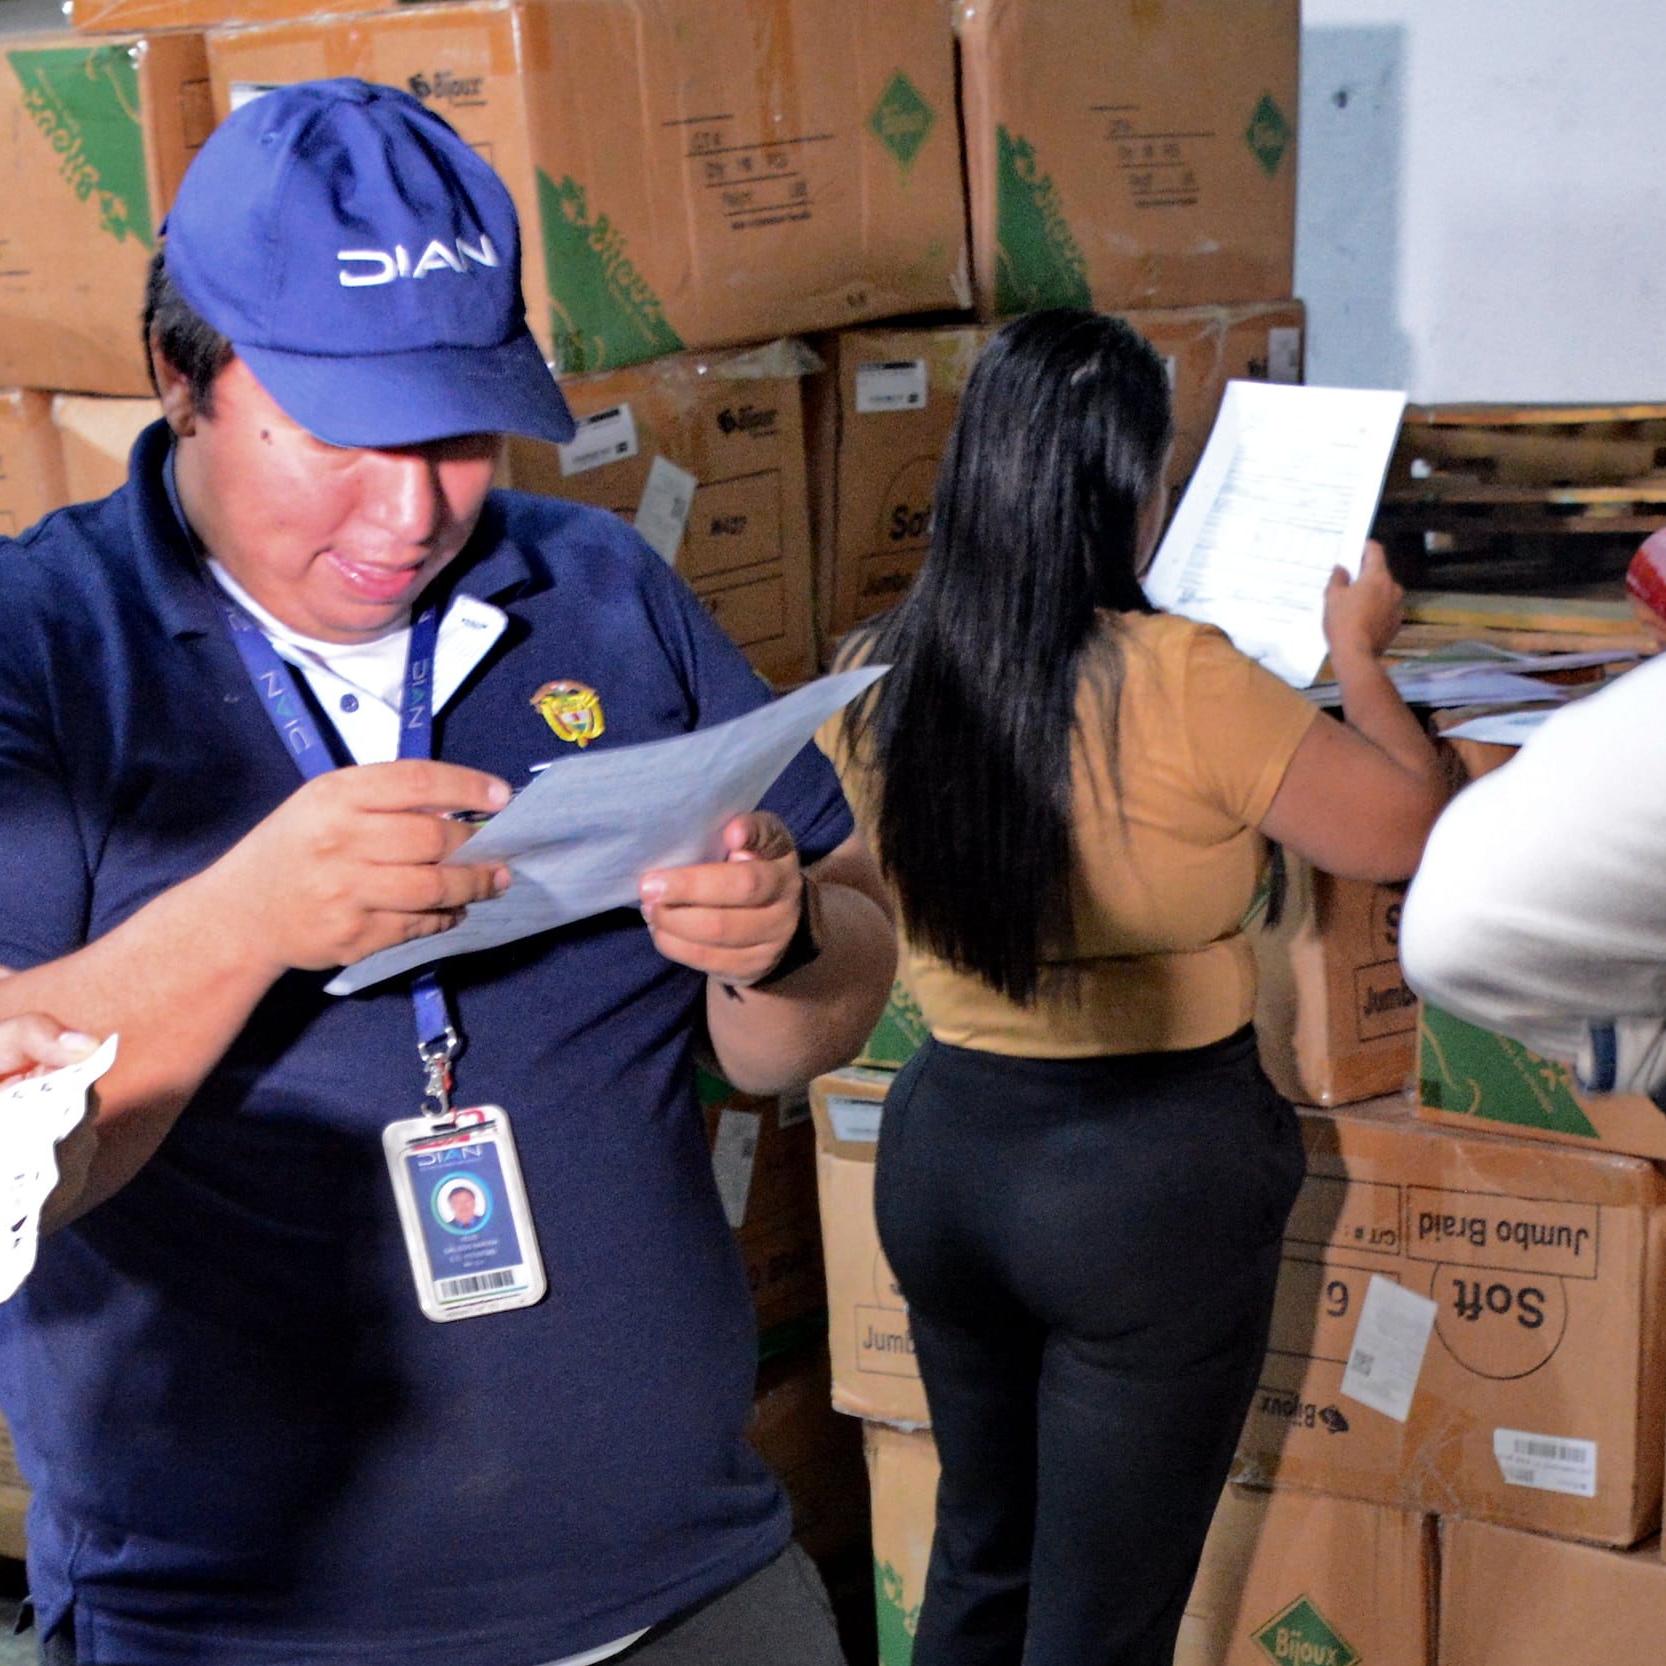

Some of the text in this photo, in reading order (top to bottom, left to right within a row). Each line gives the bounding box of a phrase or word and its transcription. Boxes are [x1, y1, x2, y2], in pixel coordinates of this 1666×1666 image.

[336, 233, 500, 288] DIAN
[259, 670, 311, 756] DIAN
[406, 655, 432, 731] DIAN
[1418, 1211, 1589, 1256] Jumbo Braid
[1452, 1278, 1546, 1330] Soft
